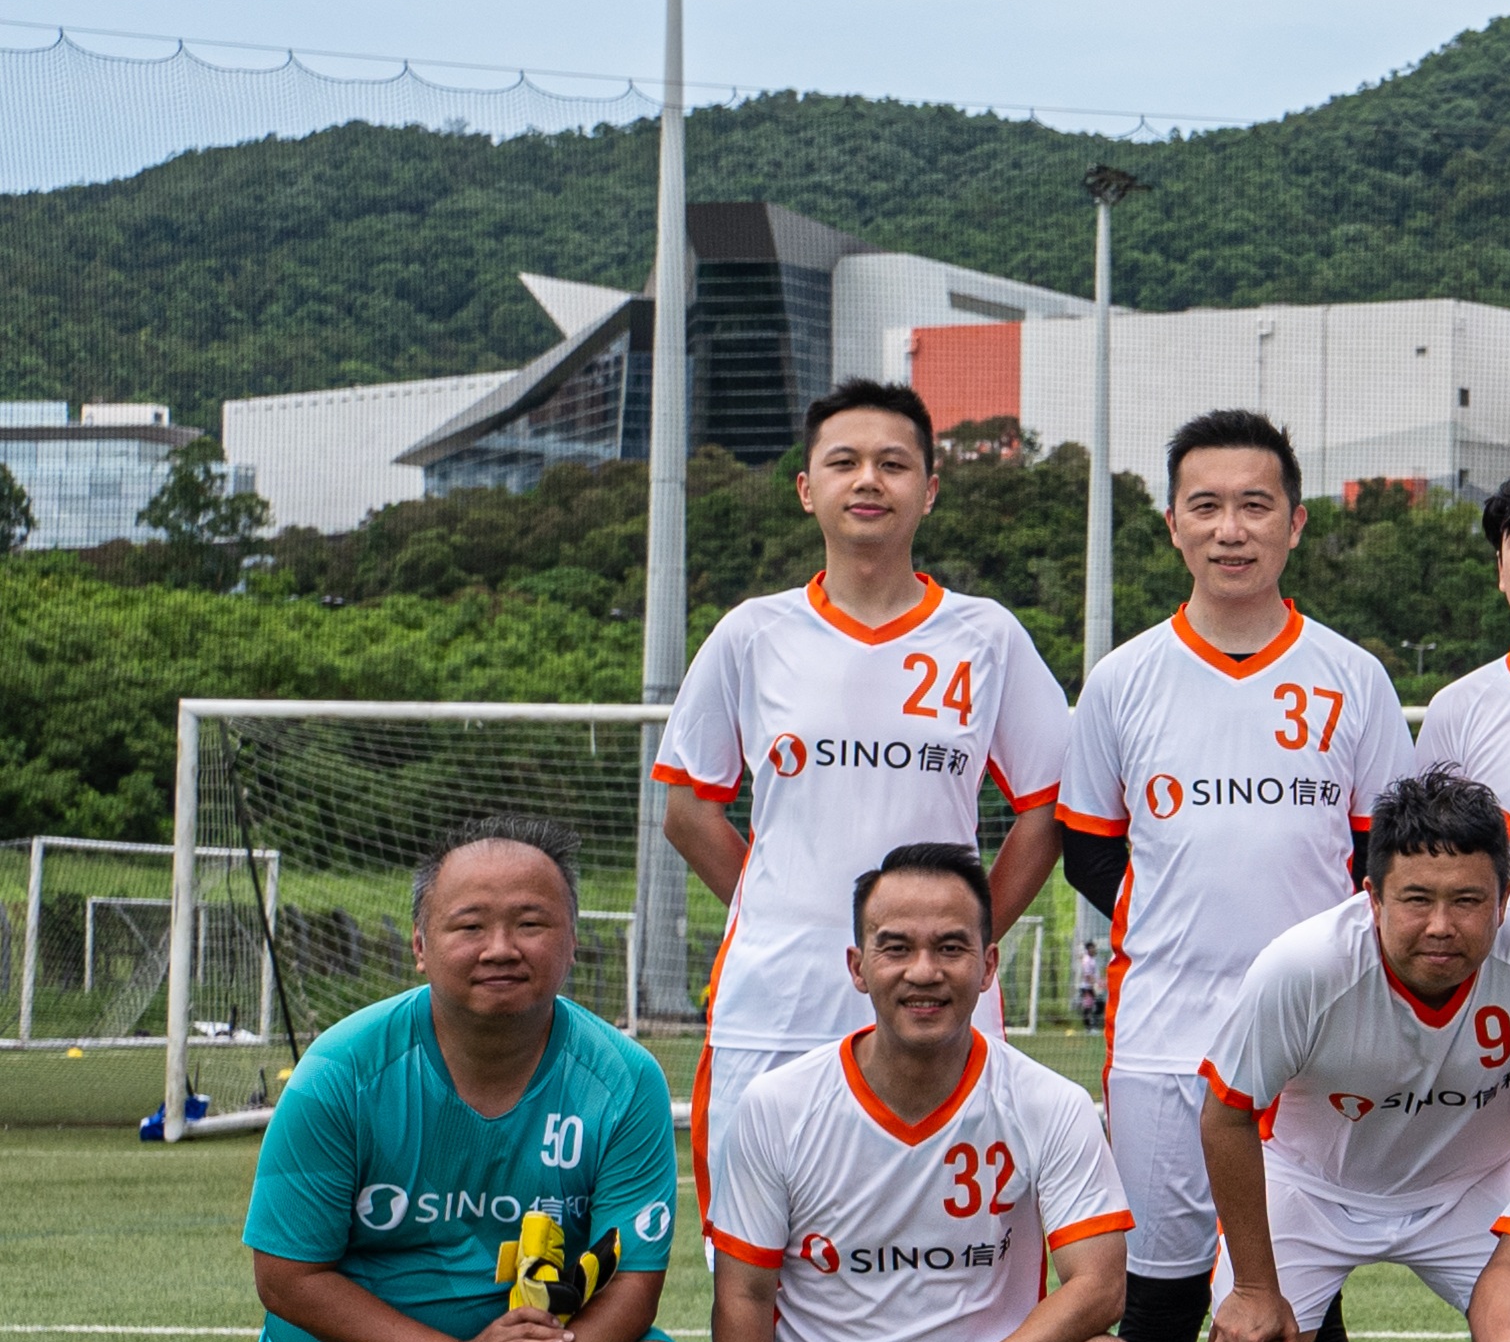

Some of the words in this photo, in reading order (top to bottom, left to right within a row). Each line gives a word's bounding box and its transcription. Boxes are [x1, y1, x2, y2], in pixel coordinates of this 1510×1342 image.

[902, 653, 972, 726] 24
[1273, 683, 1344, 752] 37
[815, 739, 911, 770] SINO
[917, 743, 969, 776] 信和
[1191, 777, 1284, 806] SINO
[1289, 777, 1341, 807] 信和
[540, 1113, 584, 1169] 50
[943, 1141, 1016, 1219] 32
[414, 1190, 522, 1225] SINO
[850, 1246, 954, 1274] SINO
